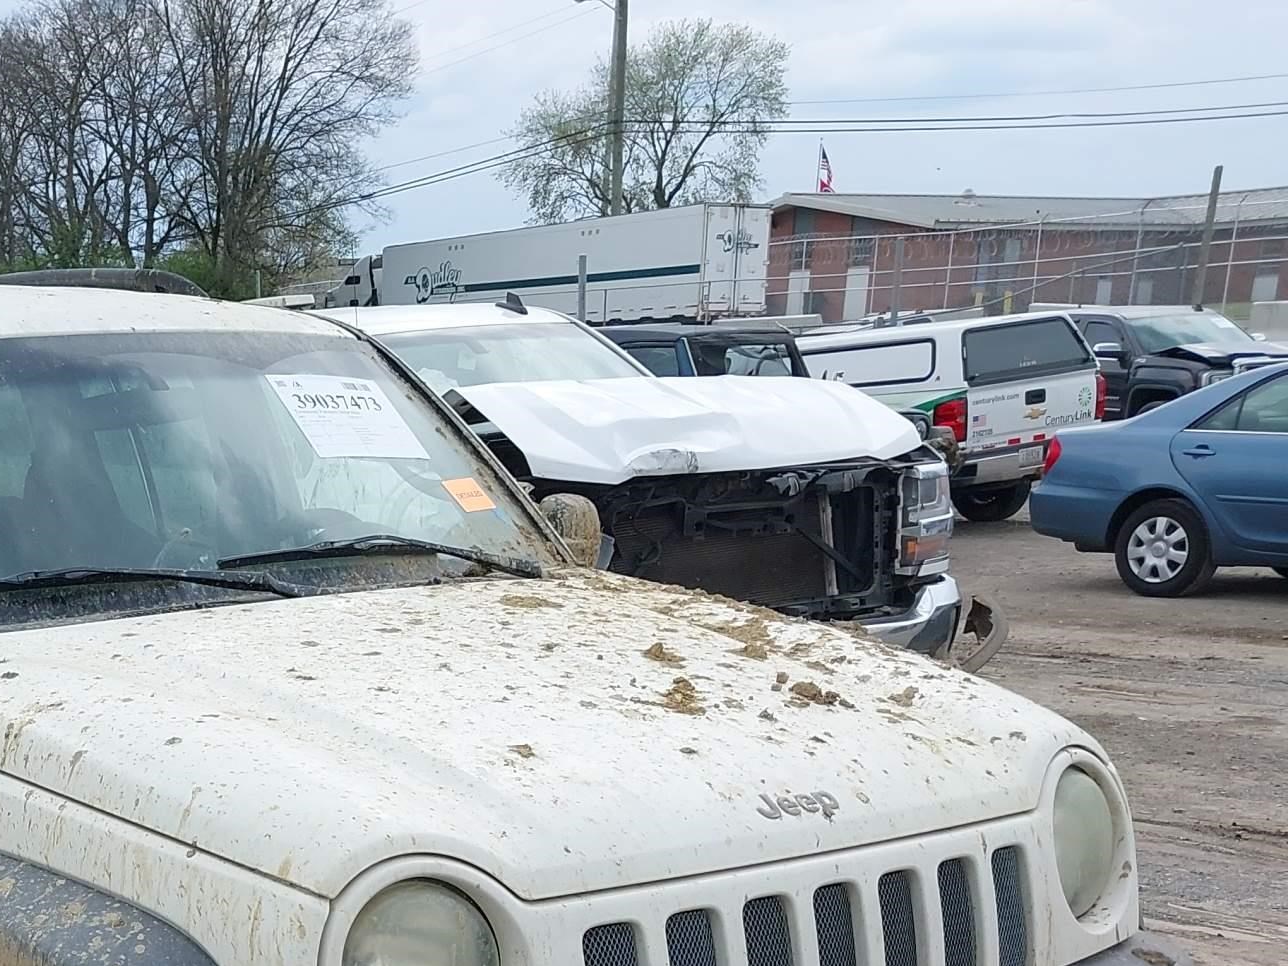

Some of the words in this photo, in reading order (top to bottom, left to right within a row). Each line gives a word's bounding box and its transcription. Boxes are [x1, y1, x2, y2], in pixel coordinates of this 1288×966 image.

[292, 393, 383, 412] 39037473
[1045, 409, 1092, 426] CenturyLink
[756, 790, 840, 821] Jeep
